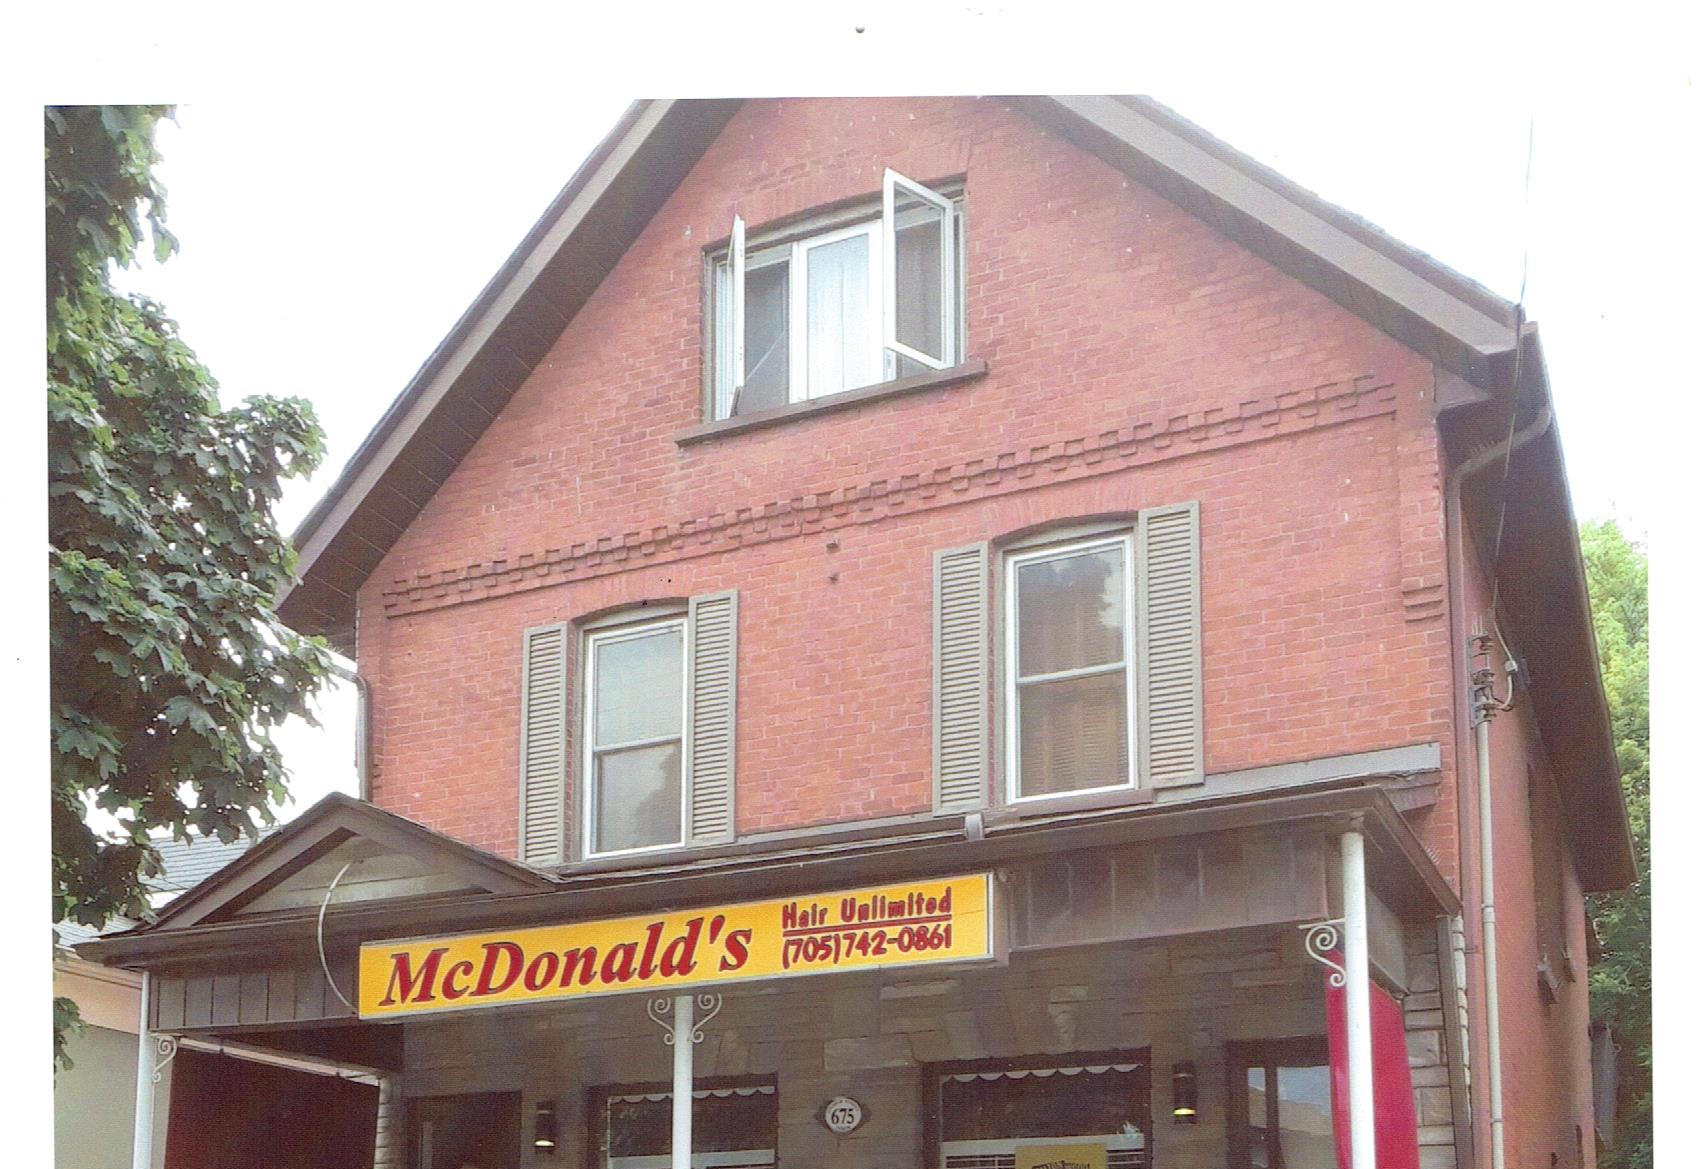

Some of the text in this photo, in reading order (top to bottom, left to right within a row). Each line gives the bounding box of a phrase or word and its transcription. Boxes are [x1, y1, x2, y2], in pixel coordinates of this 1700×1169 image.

[782, 886, 952, 929] Hair Unlimited
[378, 905, 753, 1007] McDonald's
[782, 924, 952, 970] (705)742-0861
[831, 1108, 855, 1125] 675
